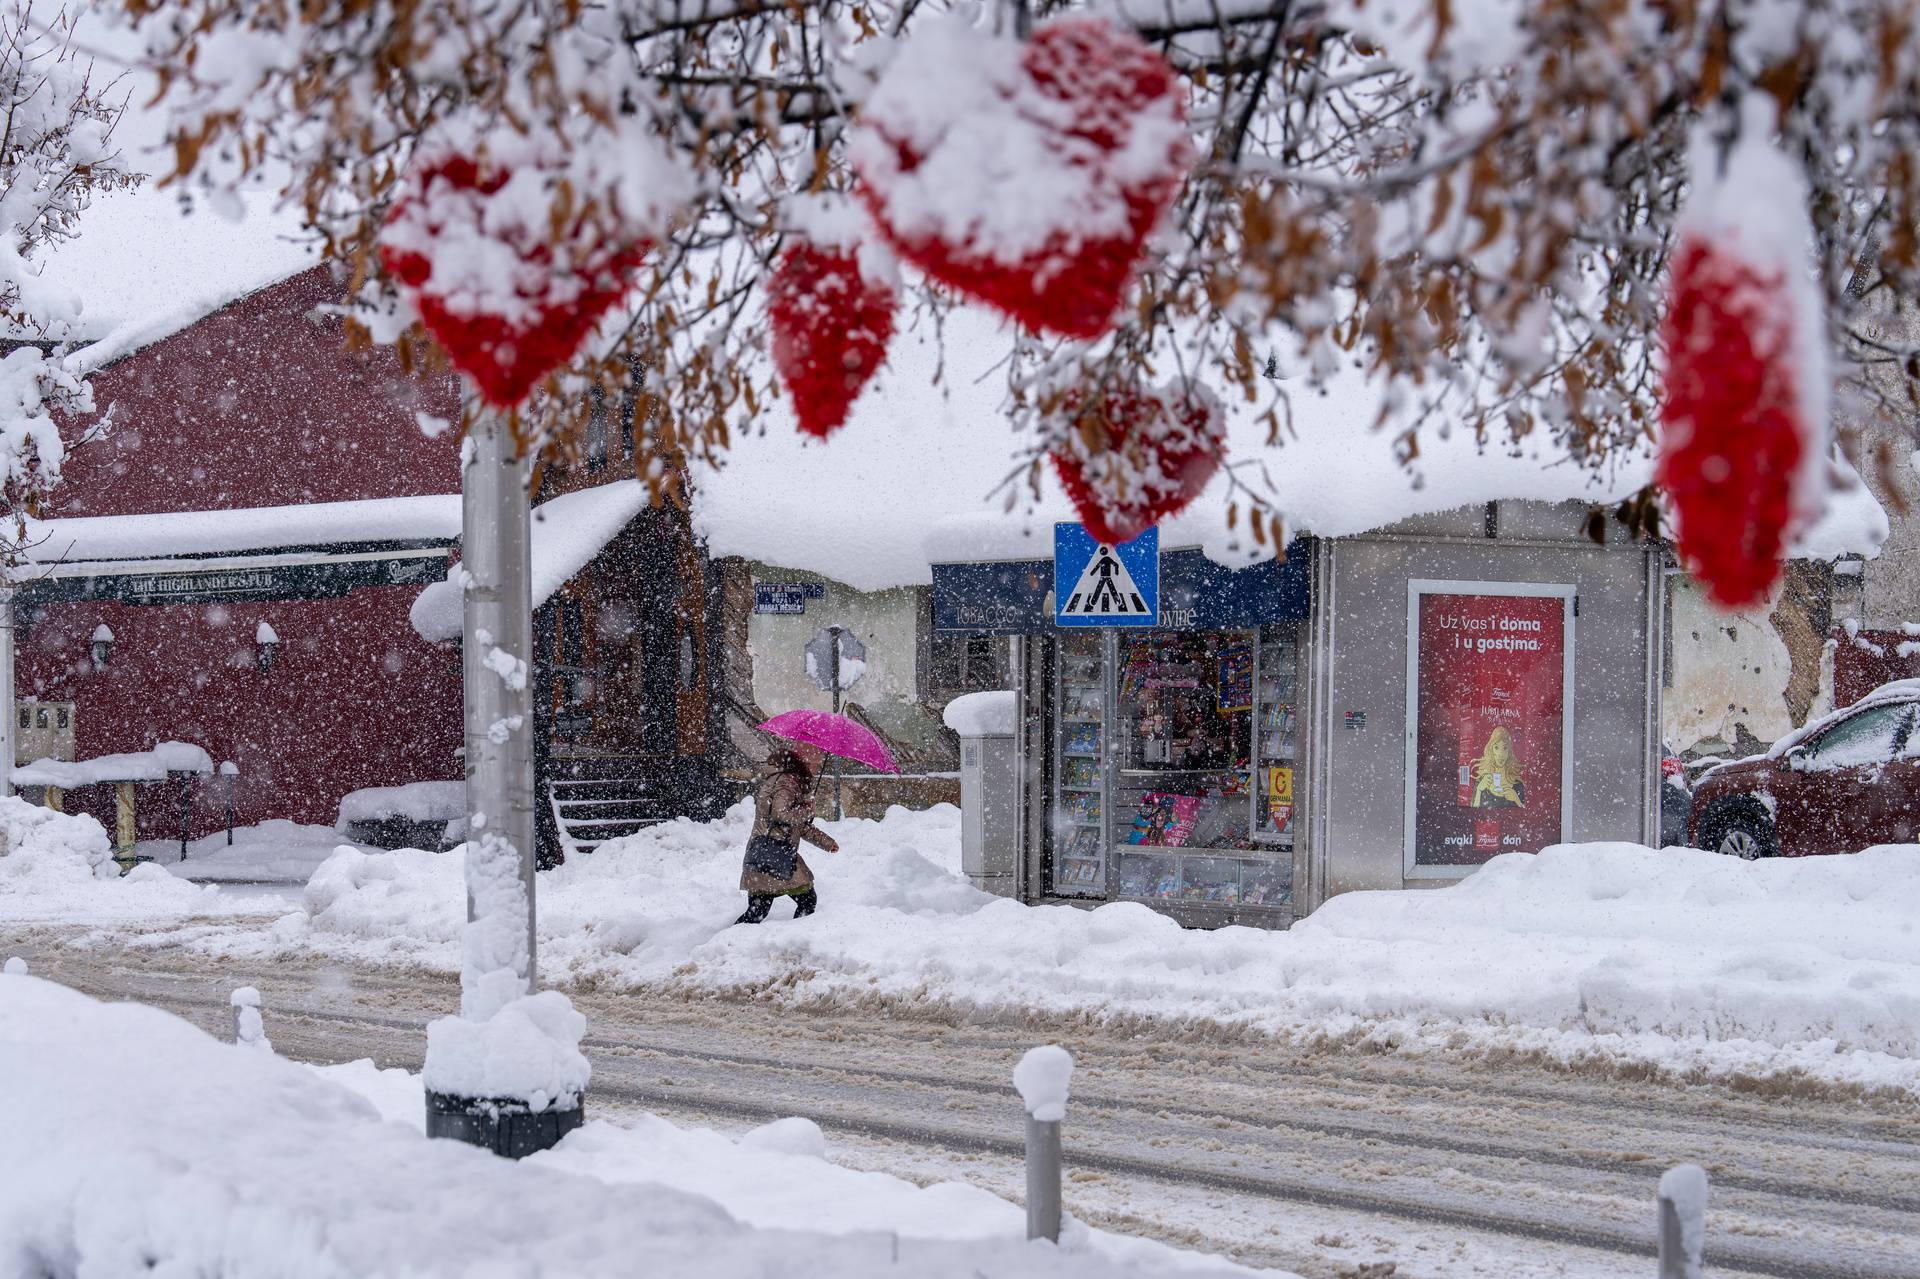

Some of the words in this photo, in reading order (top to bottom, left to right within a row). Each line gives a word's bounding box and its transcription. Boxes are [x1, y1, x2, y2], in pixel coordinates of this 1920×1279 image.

[133, 579, 156, 592] THE
[251, 573, 274, 587] PUB
[956, 605, 1017, 624] TOBACCO
[1158, 608, 1198, 627] ovine
[1440, 614, 1458, 628] Uz
[1462, 619, 1487, 629] vas
[1491, 615, 1496, 630] i
[1500, 616, 1540, 630] doma
[1455, 633, 1459, 648] i
[1464, 639, 1472, 649] u
[1477, 635, 1540, 653] gostima.
[1444, 833, 1473, 845] svaki
[1502, 834, 1522, 845] dan
